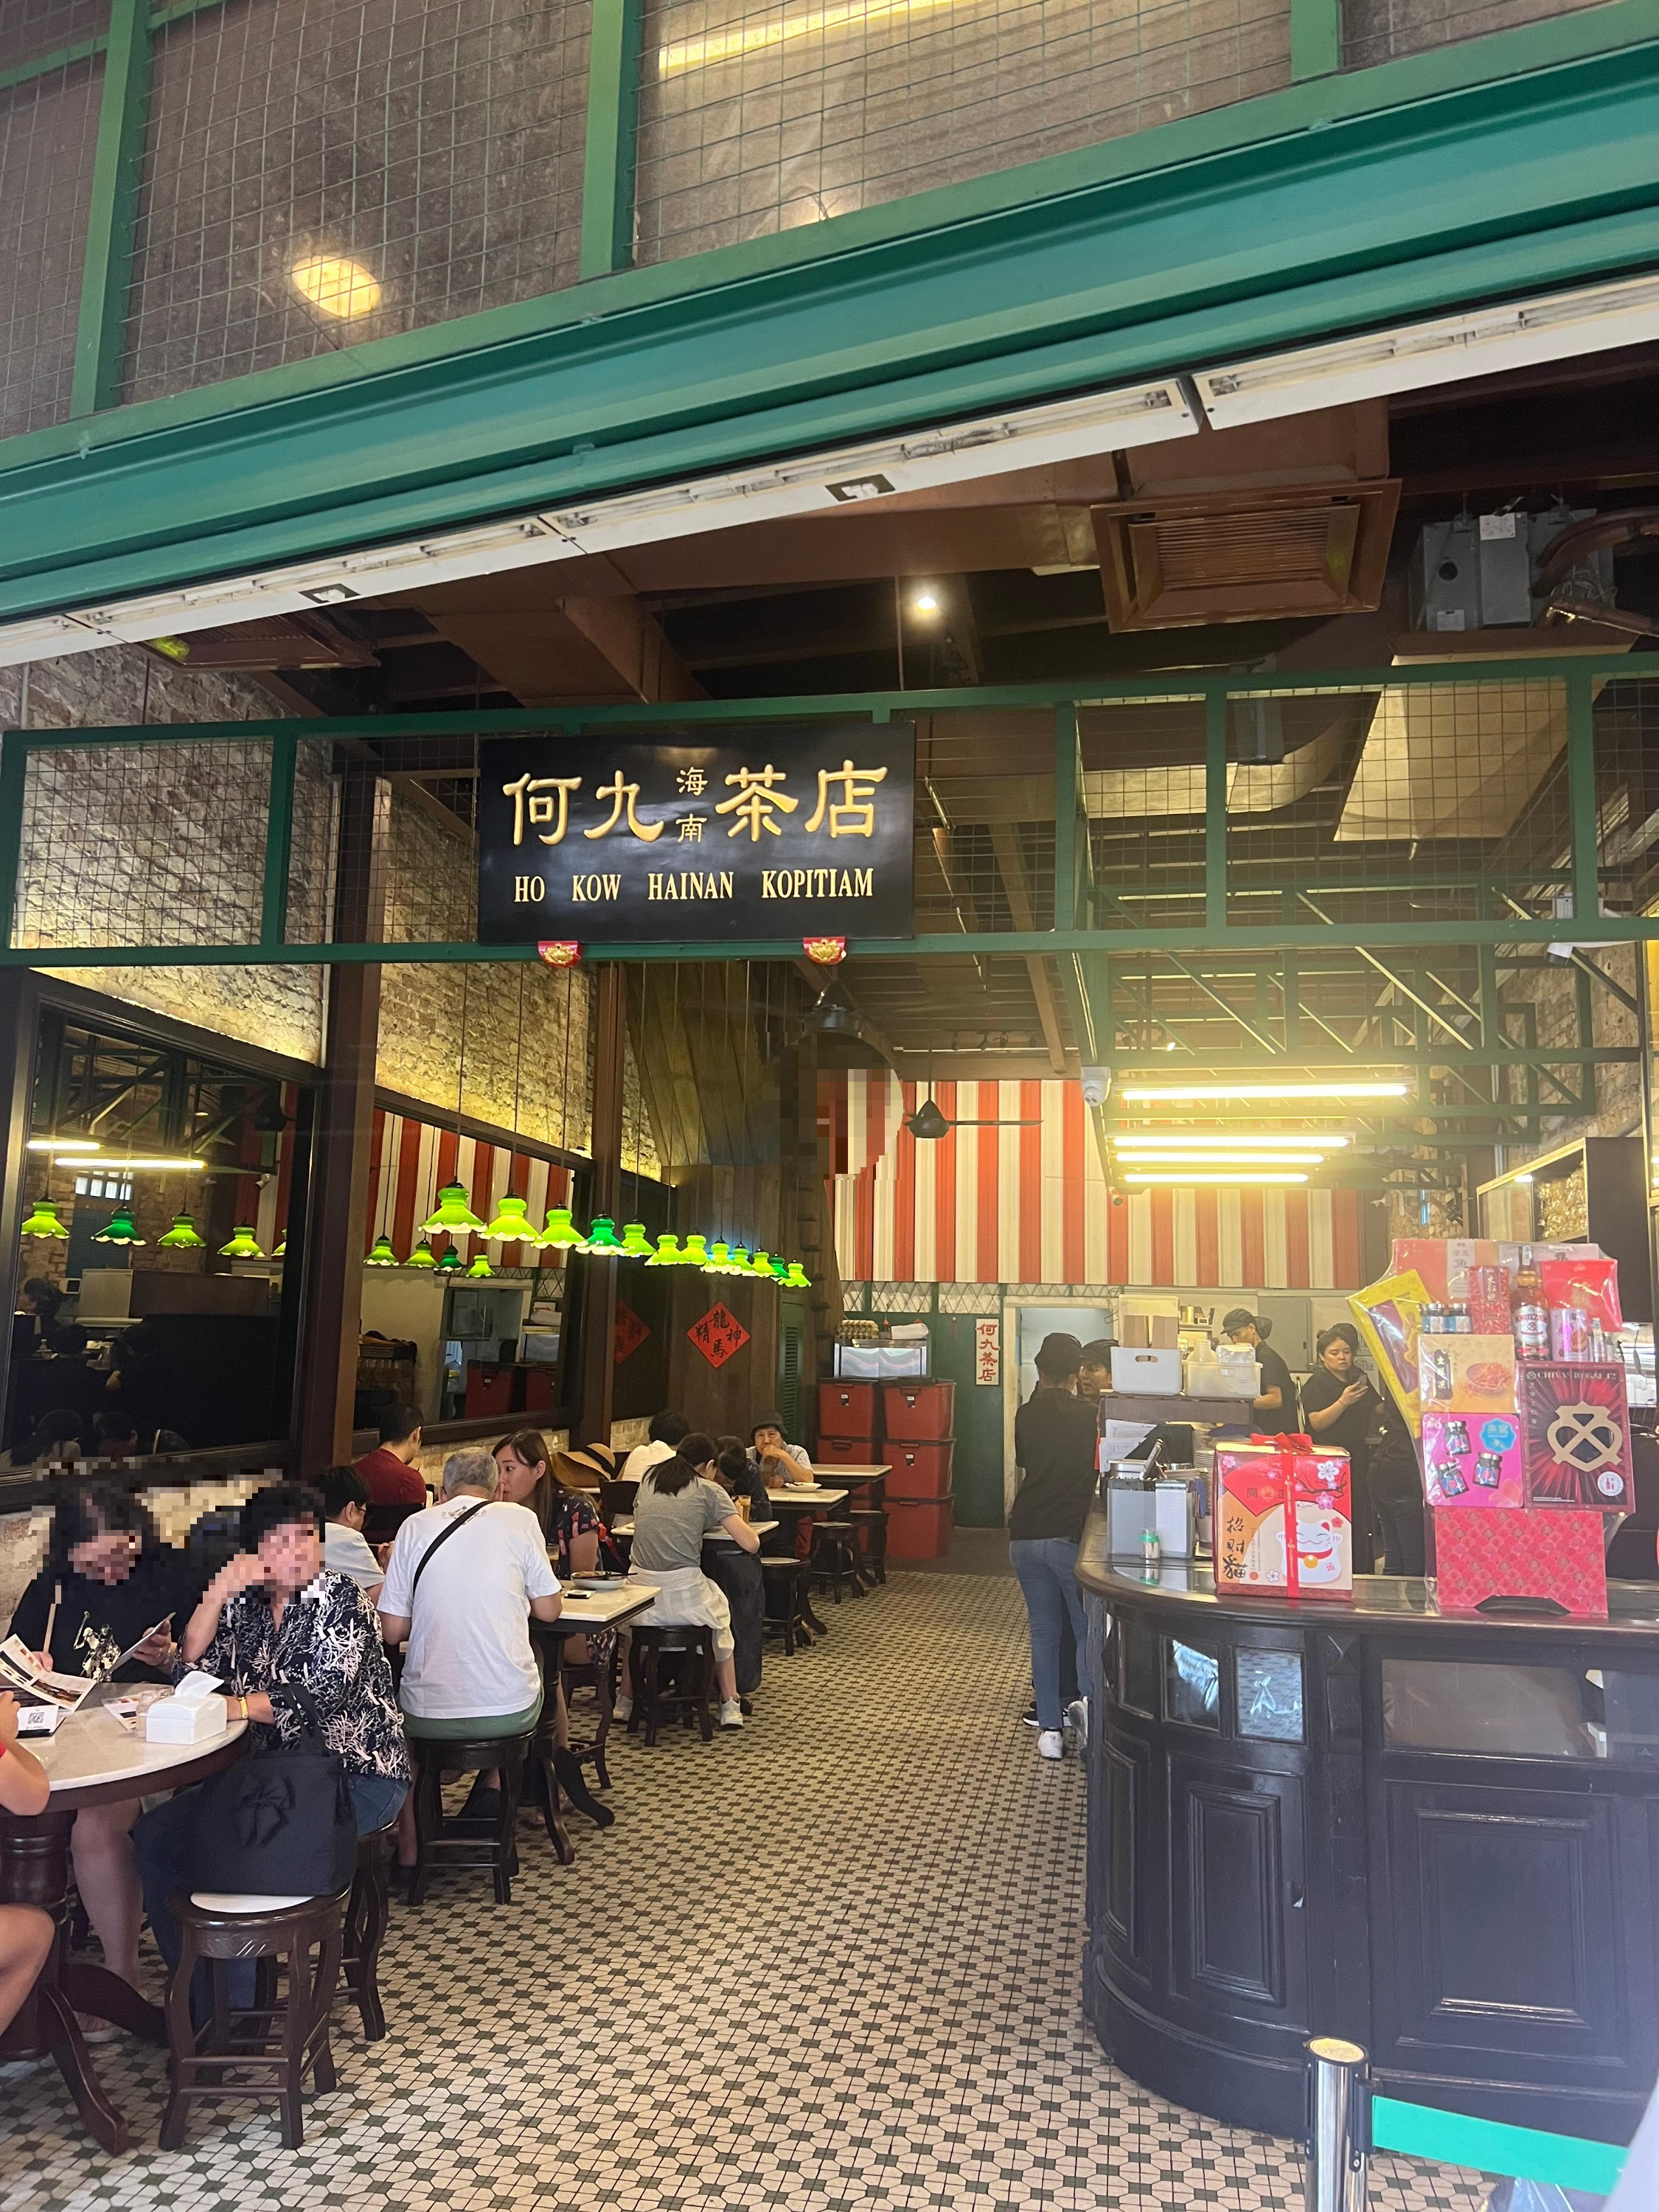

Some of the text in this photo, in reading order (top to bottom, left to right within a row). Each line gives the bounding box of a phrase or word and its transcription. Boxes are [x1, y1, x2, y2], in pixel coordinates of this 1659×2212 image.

[514, 868, 874, 902] HO KOW HAINAN KOPITIAM
[975, 1324, 1000, 1381] 何九茶店
